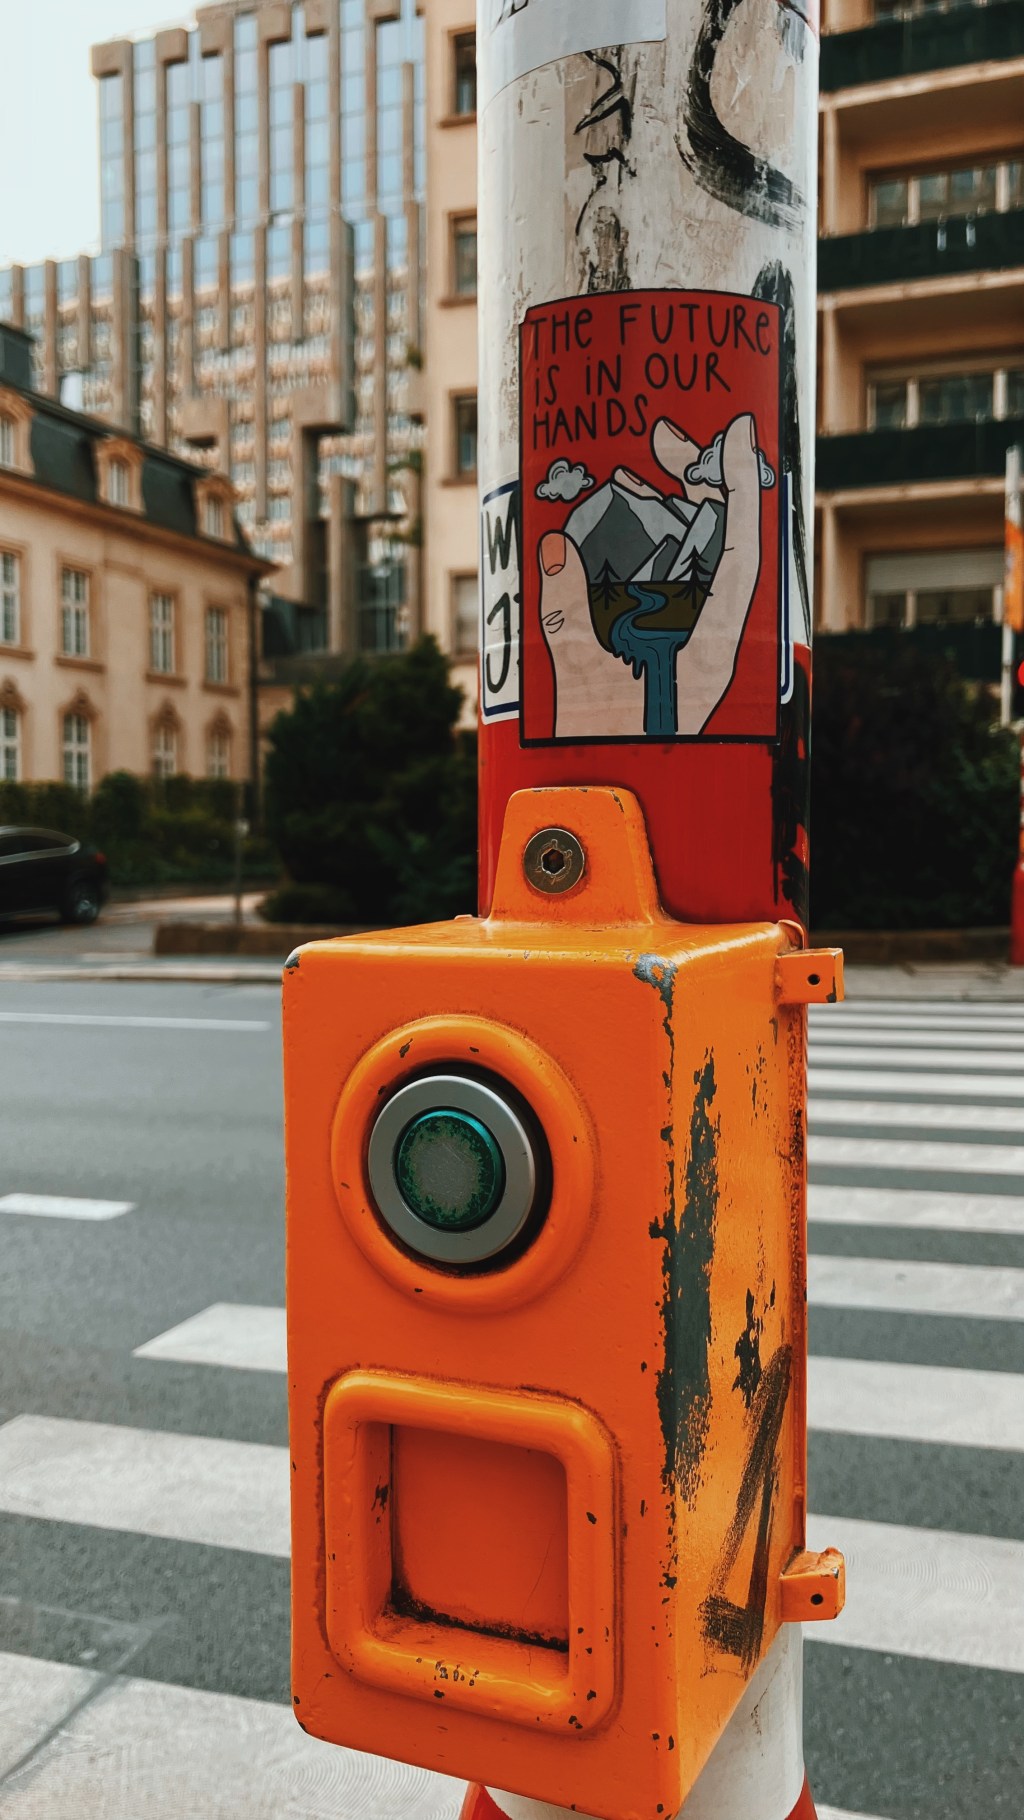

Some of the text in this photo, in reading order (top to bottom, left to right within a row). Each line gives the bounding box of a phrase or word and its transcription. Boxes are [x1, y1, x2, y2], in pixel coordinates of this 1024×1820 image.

[535, 352, 731, 406] iS iN OUR
[533, 394, 649, 450] HANDS
